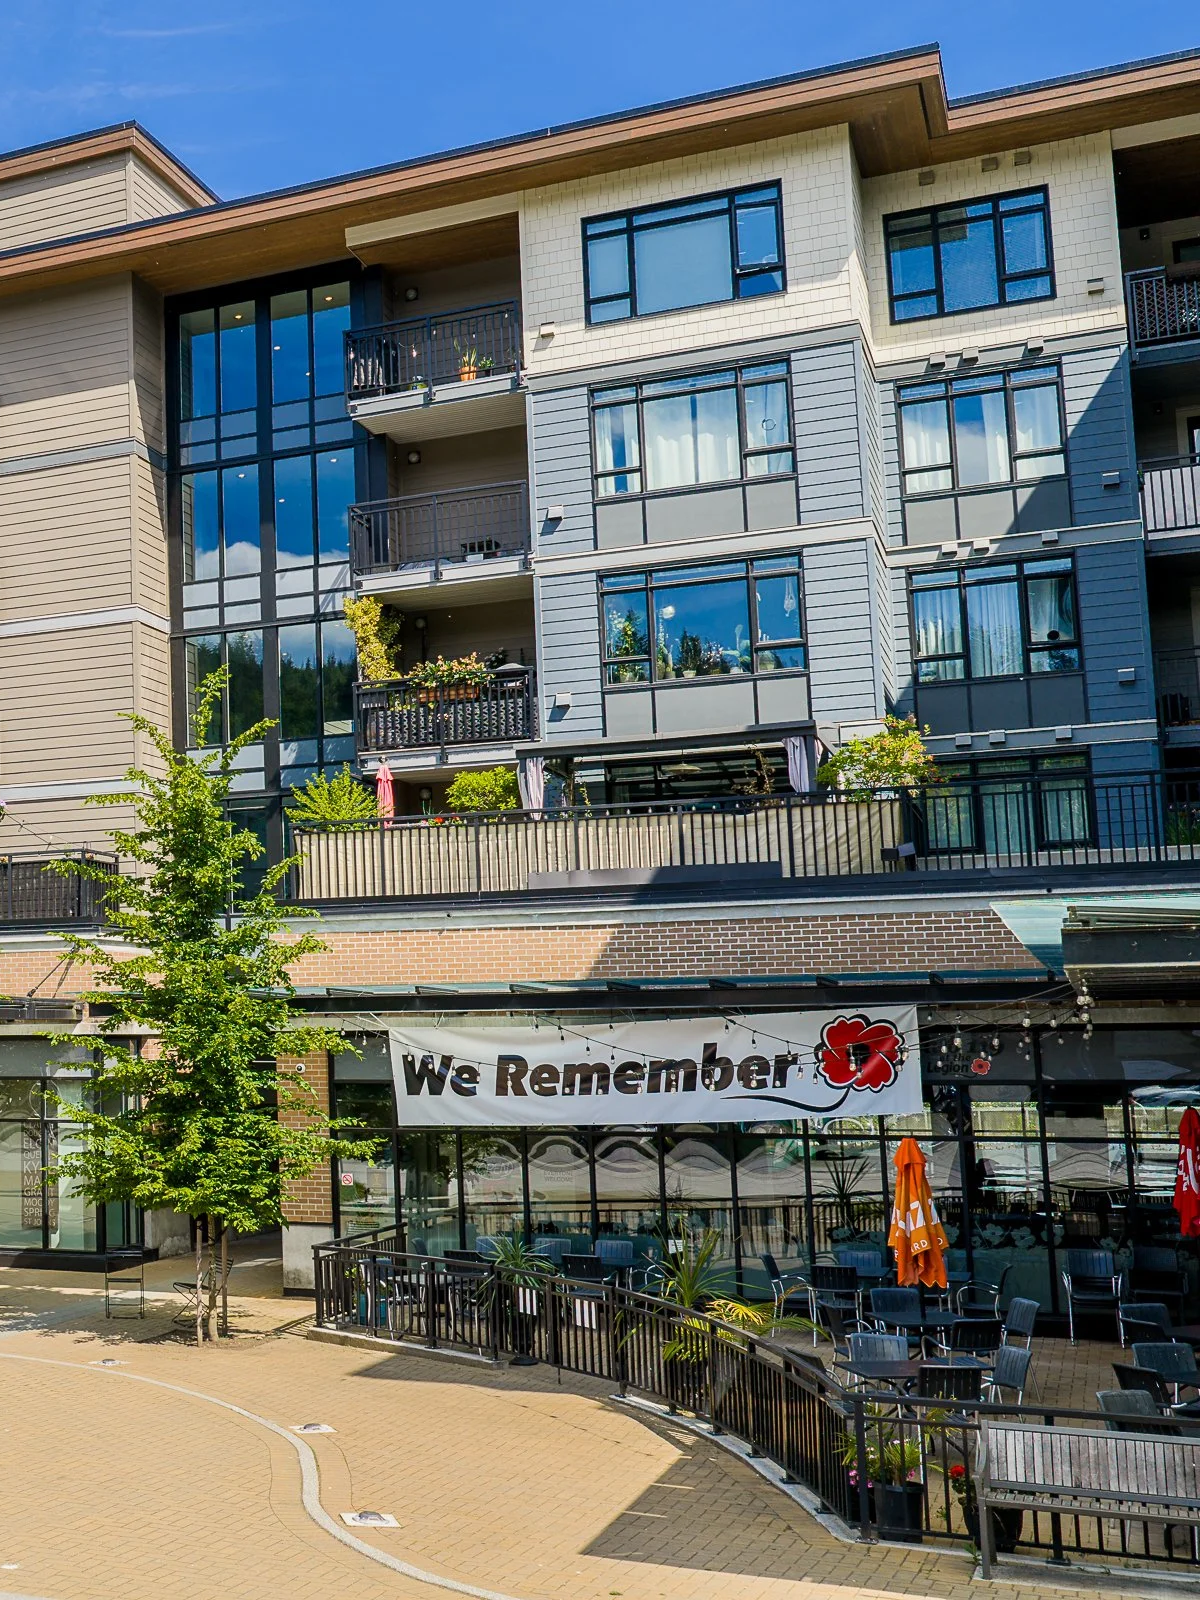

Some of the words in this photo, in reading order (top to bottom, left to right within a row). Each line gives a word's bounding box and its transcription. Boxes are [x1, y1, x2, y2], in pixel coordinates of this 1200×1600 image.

[402, 1054, 479, 1097] We
[495, 1043, 798, 1097] Remember
[927, 1062, 969, 1076] Legion
